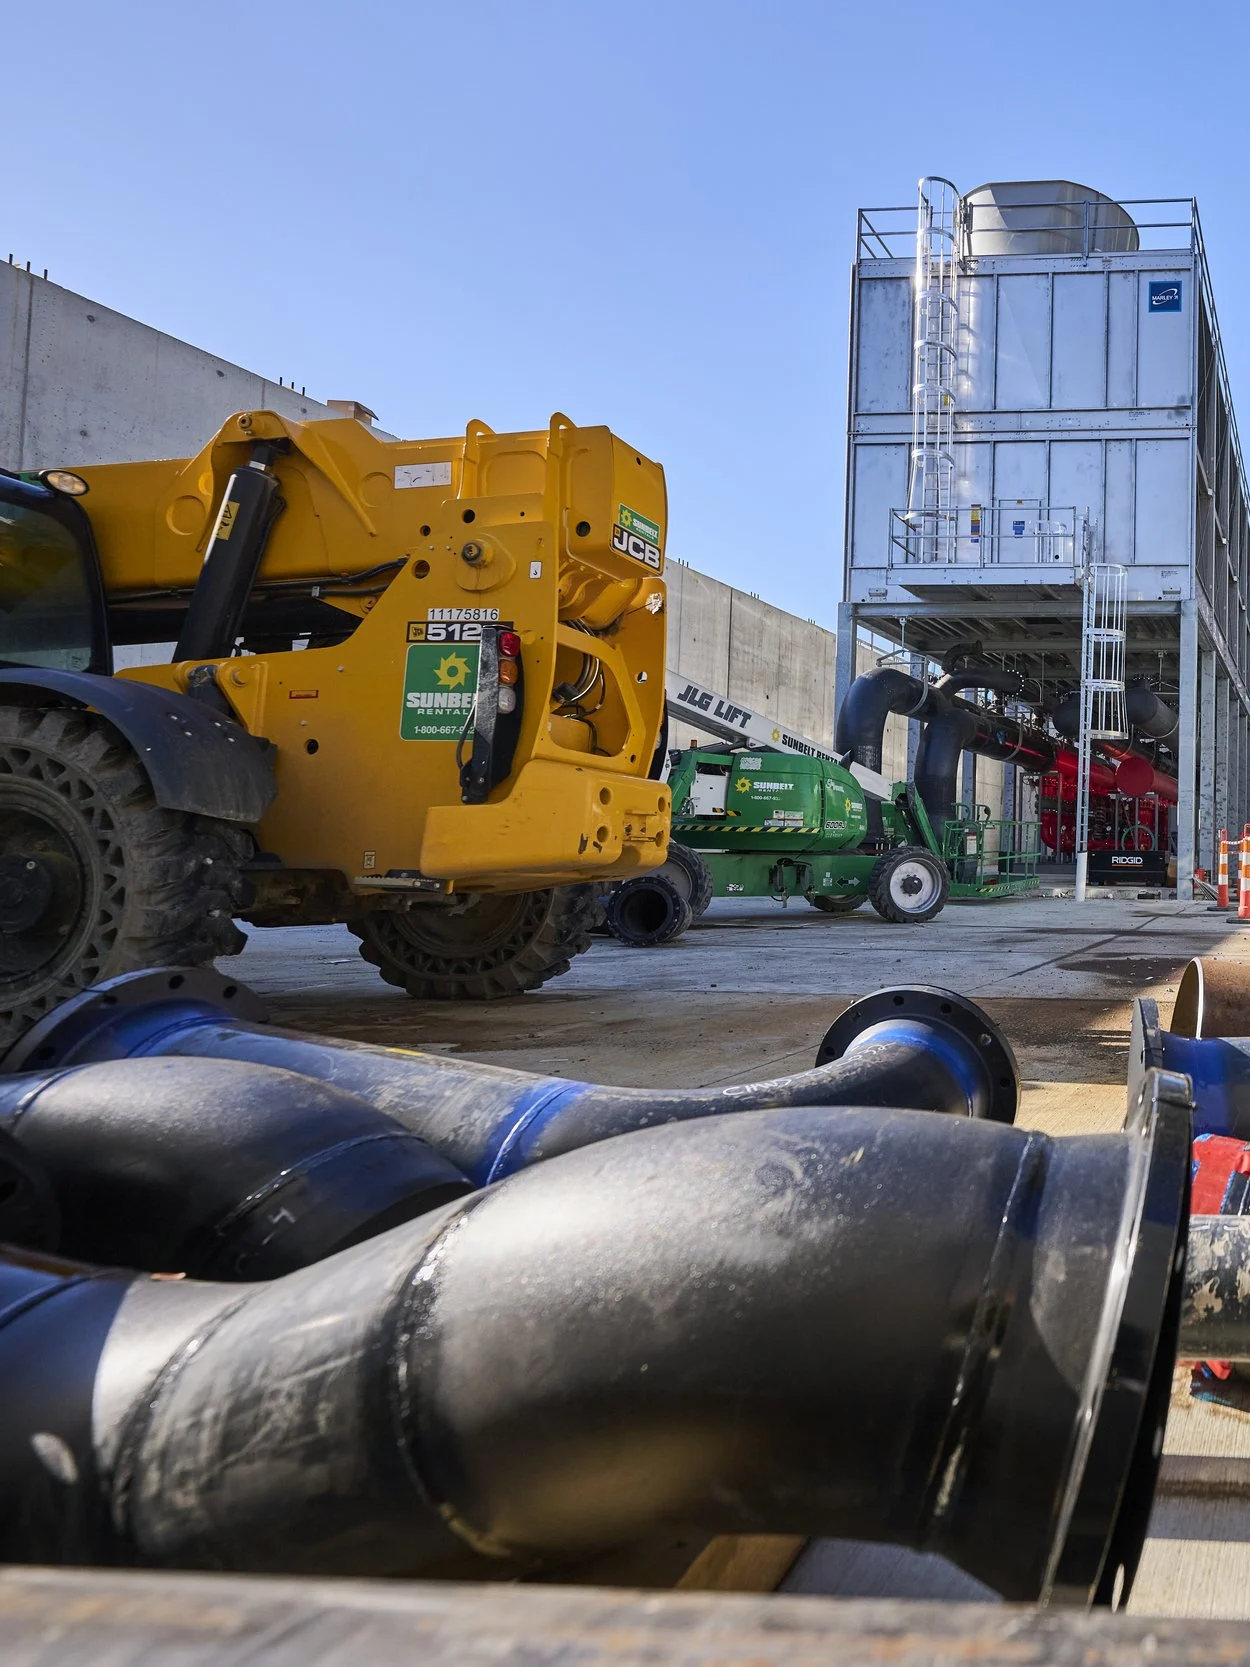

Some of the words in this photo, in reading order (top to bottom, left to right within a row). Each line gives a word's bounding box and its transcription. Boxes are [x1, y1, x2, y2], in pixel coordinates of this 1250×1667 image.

[613, 530, 660, 569] JCB
[429, 609, 499, 620] 11175816
[426, 623, 482, 641] 512
[677, 684, 714, 712] JLG
[713, 700, 752, 729] LIFT
[414, 725, 475, 734] 1-800-667-92
[781, 733, 816, 757] SUNBELT
[753, 781, 794, 790] SUNBELT
[1111, 856, 1143, 864] RIDGID
